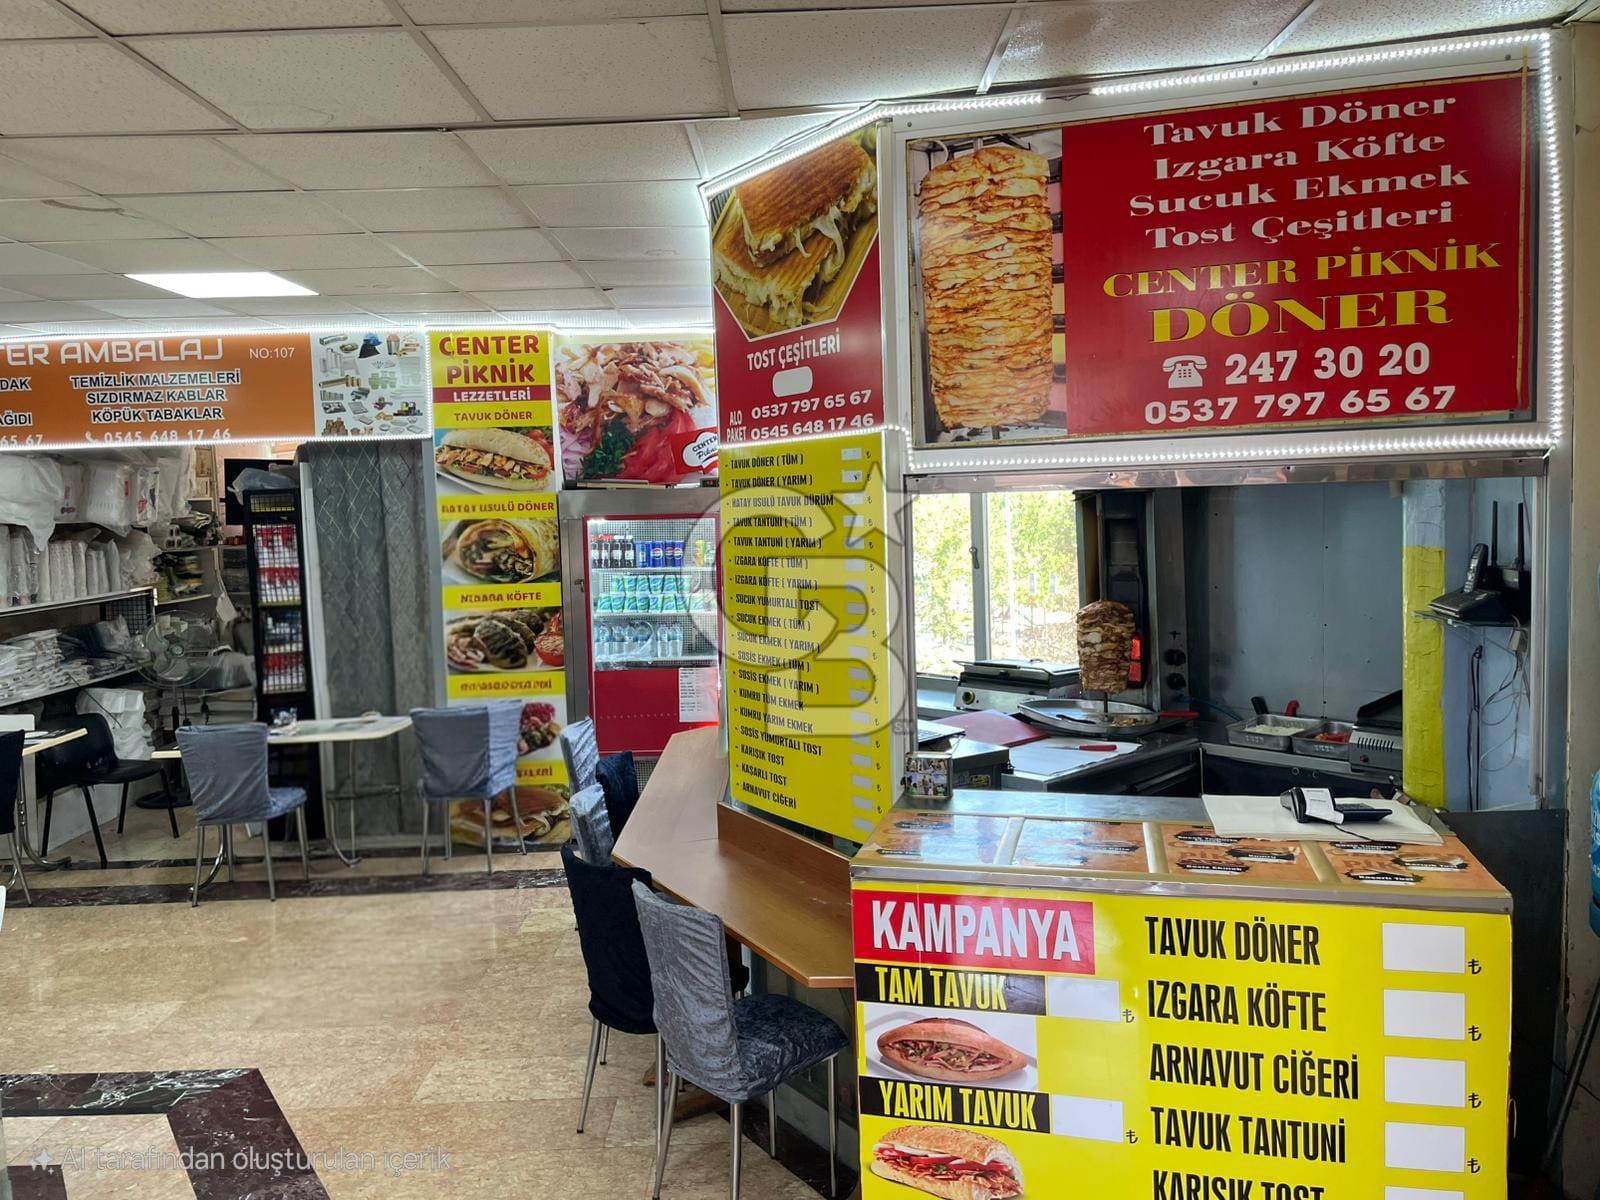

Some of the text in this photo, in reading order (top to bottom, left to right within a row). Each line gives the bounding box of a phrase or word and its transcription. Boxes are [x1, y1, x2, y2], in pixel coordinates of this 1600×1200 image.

[1143, 97, 1457, 146] Tavuk Döner
[1154, 131, 1445, 182] Izgara Köfte
[1130, 164, 1472, 217] Sucuk Ekmek
[1146, 201, 1452, 250] Tost Çeşitleri
[1102, 238, 1503, 298] CENTER PİKNİK
[1148, 289, 1454, 343] DÖNER
[60, 338, 223, 365] AMBALAJ
[249, 347, 295, 359] NO:107
[439, 335, 539, 356] CENTER
[747, 328, 840, 371] TOST ÇEŞİTLERİ
[447, 358, 535, 384] PİKNİK
[1224, 342, 1430, 385] 247 30 20
[72, 369, 240, 388] TEMİZLİK MALZEMELERİ
[87, 389, 225, 404] SIZDIRMAZ KABLAR
[453, 387, 531, 402] LEZZETLERİ
[752, 390, 872, 419] 0537 797 65 67
[1145, 386, 1456, 425] 0537 797 65 67
[92, 408, 223, 423] KÖPÜK TABAKLAR
[454, 410, 532, 421] TAVUK DÖNER
[730, 410, 743, 425] ALO
[104, 428, 231, 442] 0545 648 17 46
[751, 413, 874, 440] 0545 648 17 46
[731, 459, 750, 470] TAVUK
[752, 457, 774, 468] DÖNER
[732, 478, 751, 489] TAVUK
[752, 476, 775, 487] DÖNER
[518, 501, 554, 512] DÖNER
[778, 496, 801, 506] TAVUK
[804, 494, 834, 506] DÜRÜM
[734, 517, 752, 527] TAVUK
[754, 516, 782, 527] TANTUNİ
[734, 537, 753, 547] TAVUK
[754, 536, 783, 547] TANTUNİ
[734, 556, 756, 566] IZGARA
[735, 576, 757, 586] IZGARA
[507, 590, 542, 601] KÖFTE
[736, 594, 756, 605] SUCUK
[800, 600, 819, 611] TOST
[736, 613, 756, 625] SUCUK
[758, 615, 781, 627] EKMEK
[759, 634, 782, 648] EKMEK
[738, 650, 756, 662] SOSİS
[738, 669, 757, 683] SOSİS
[758, 672, 782, 687] EKMEK
[739, 688, 760, 702] KUMRU
[779, 696, 804, 711] EKMEK
[740, 707, 813, 734] KUMRU YARIM EKMEK
[760, 732, 800, 751] YUMURTALI
[803, 742, 822, 757] TOST
[768, 753, 784, 766] TOST
[769, 772, 787, 787] TOST
[742, 782, 771, 800] ARNAVUT
[872, 900, 1080, 962] KAMPANYA
[1145, 916, 1226, 959] TAVUK
[1234, 916, 1320, 966] DÖNER
[875, 966, 923, 1005] TAM
[930, 970, 1007, 1011] TAVUK
[1148, 980, 1239, 1025] IZGARA
[1248, 983, 1326, 1032] KÖFTE
[1150, 1044, 1264, 1092] ARNAVUT
[1273, 1050, 1359, 1100] CİĞERİ
[879, 1080, 952, 1121] YARIM
[960, 1088, 1036, 1130] TAVUK
[1150, 1106, 1231, 1153] TAVUK
[1238, 1116, 1346, 1163] TANTUNİ
